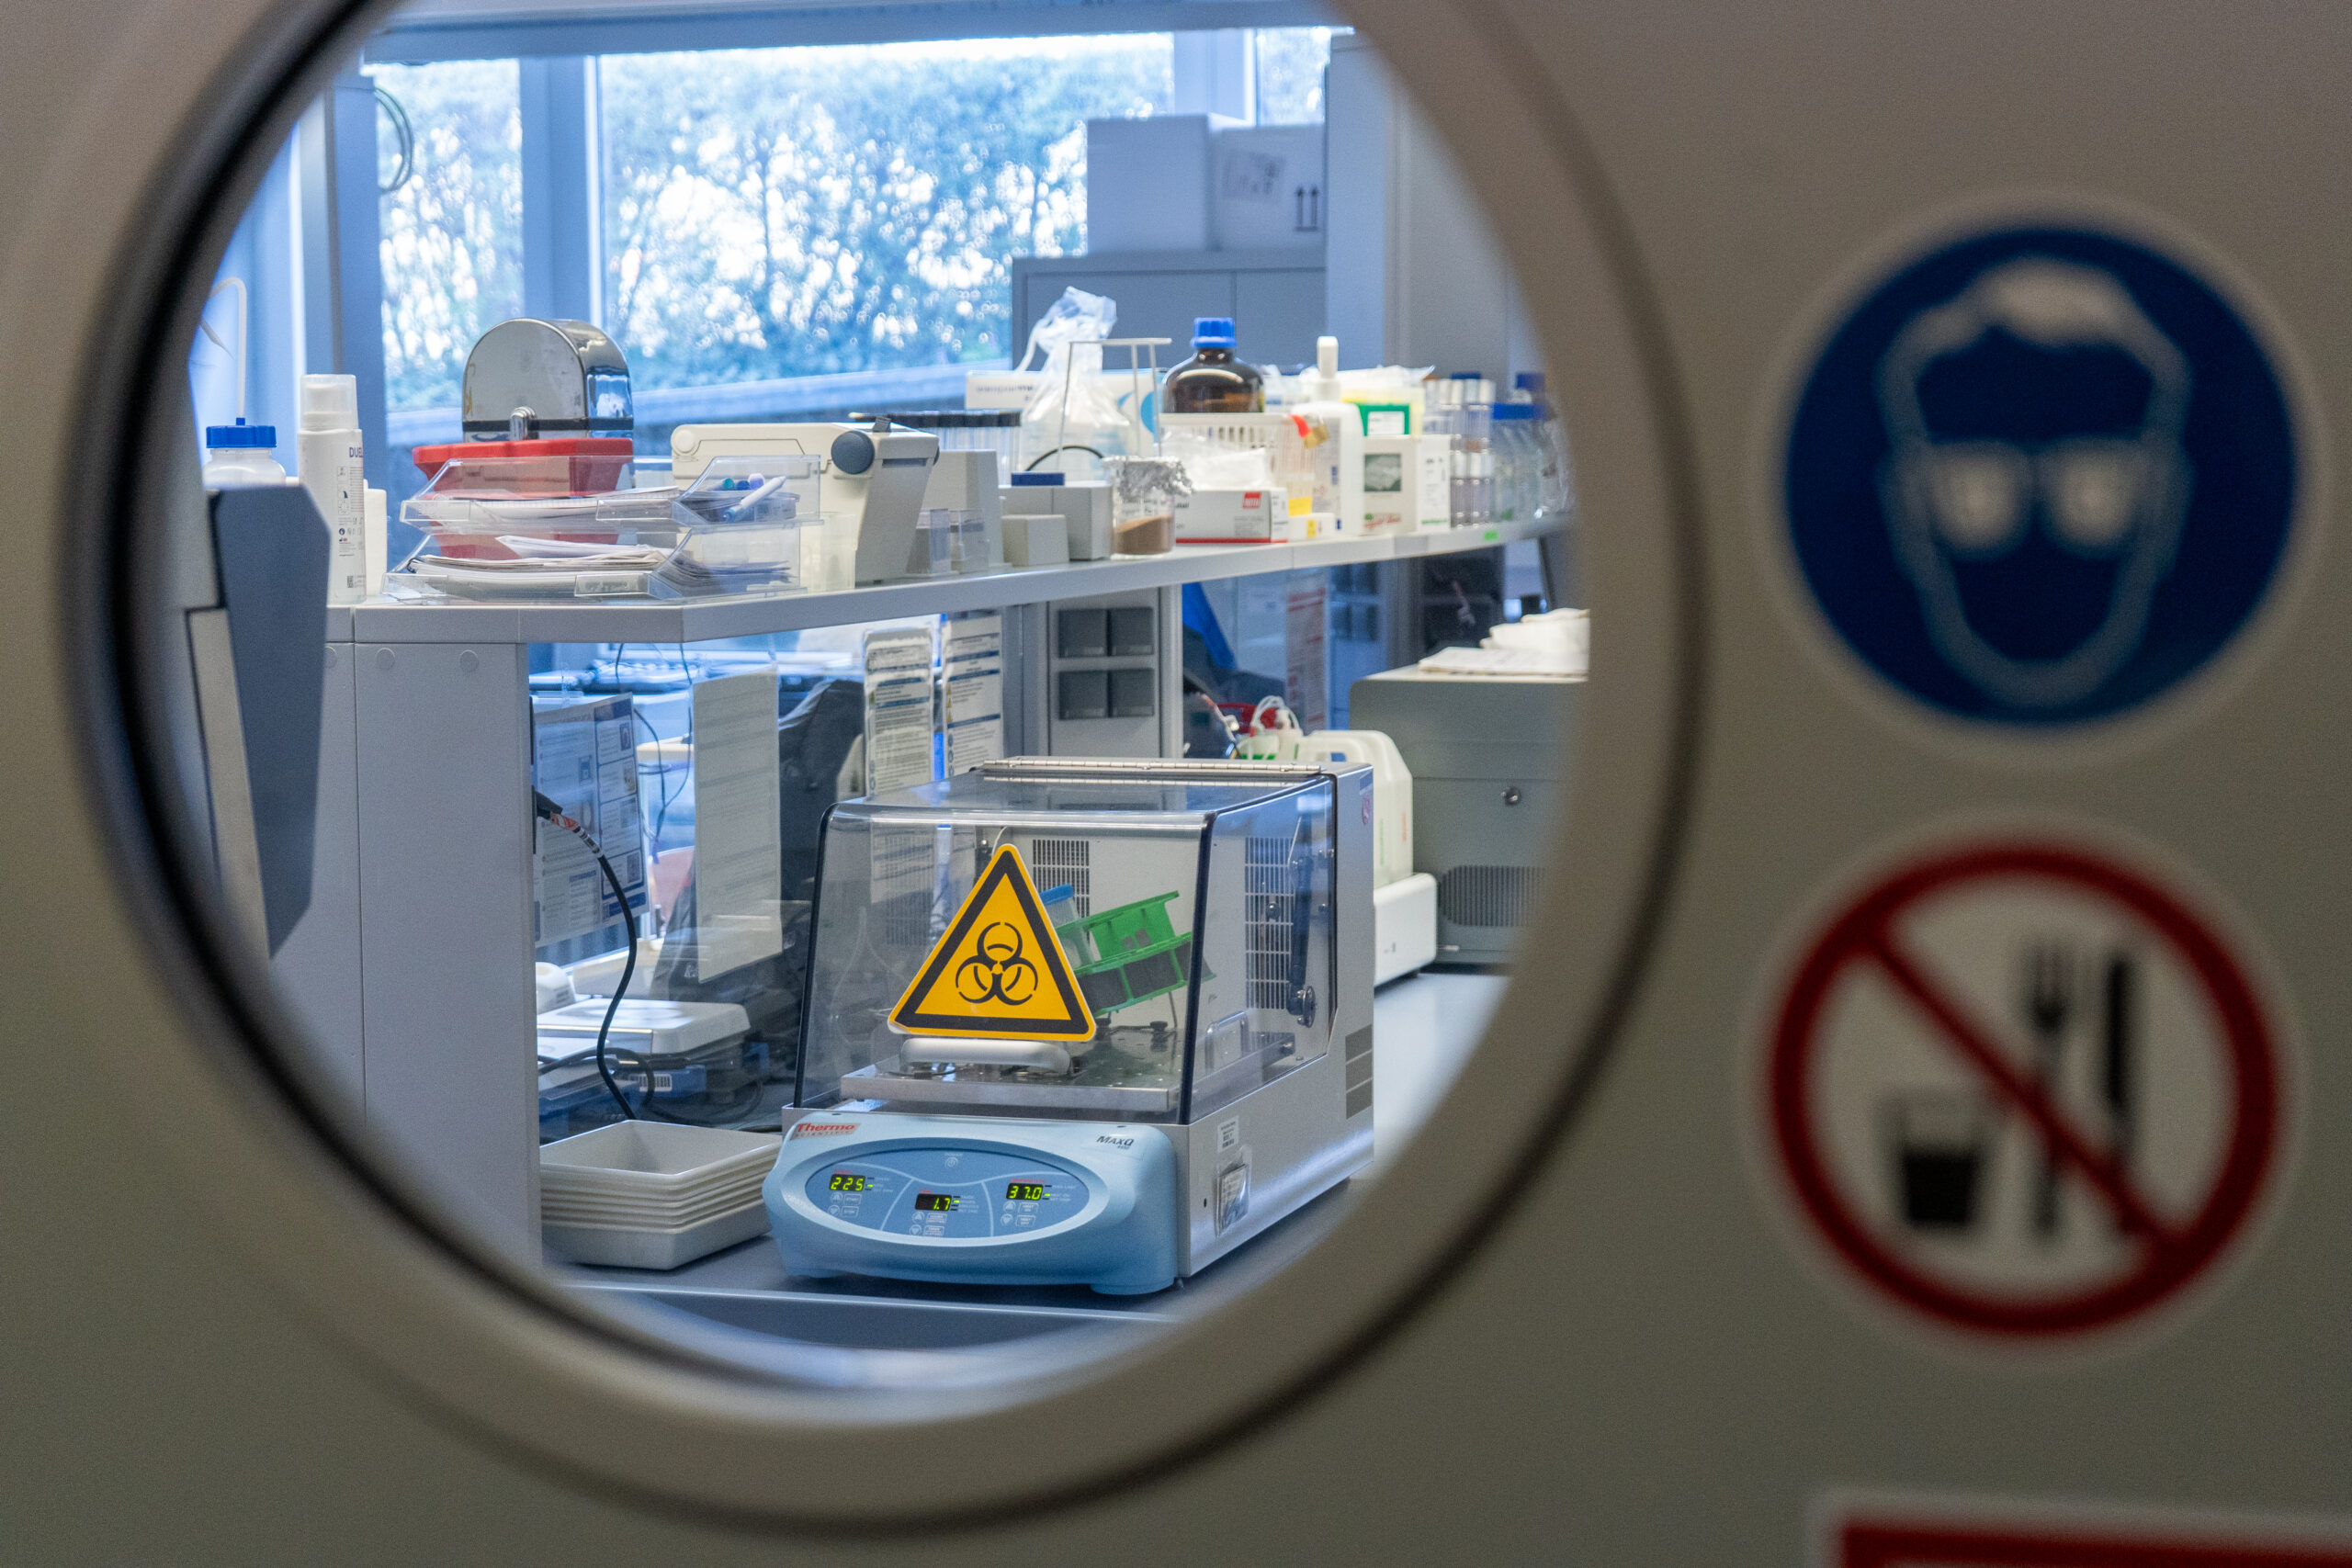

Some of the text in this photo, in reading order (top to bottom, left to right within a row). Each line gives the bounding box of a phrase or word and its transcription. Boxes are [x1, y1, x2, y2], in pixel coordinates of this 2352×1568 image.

[797, 1122, 855, 1132] Thermo
[831, 1177, 864, 1191] 225
[1009, 1185, 1043, 1201] 37.0
[933, 1197, 951, 1211] 1.7
